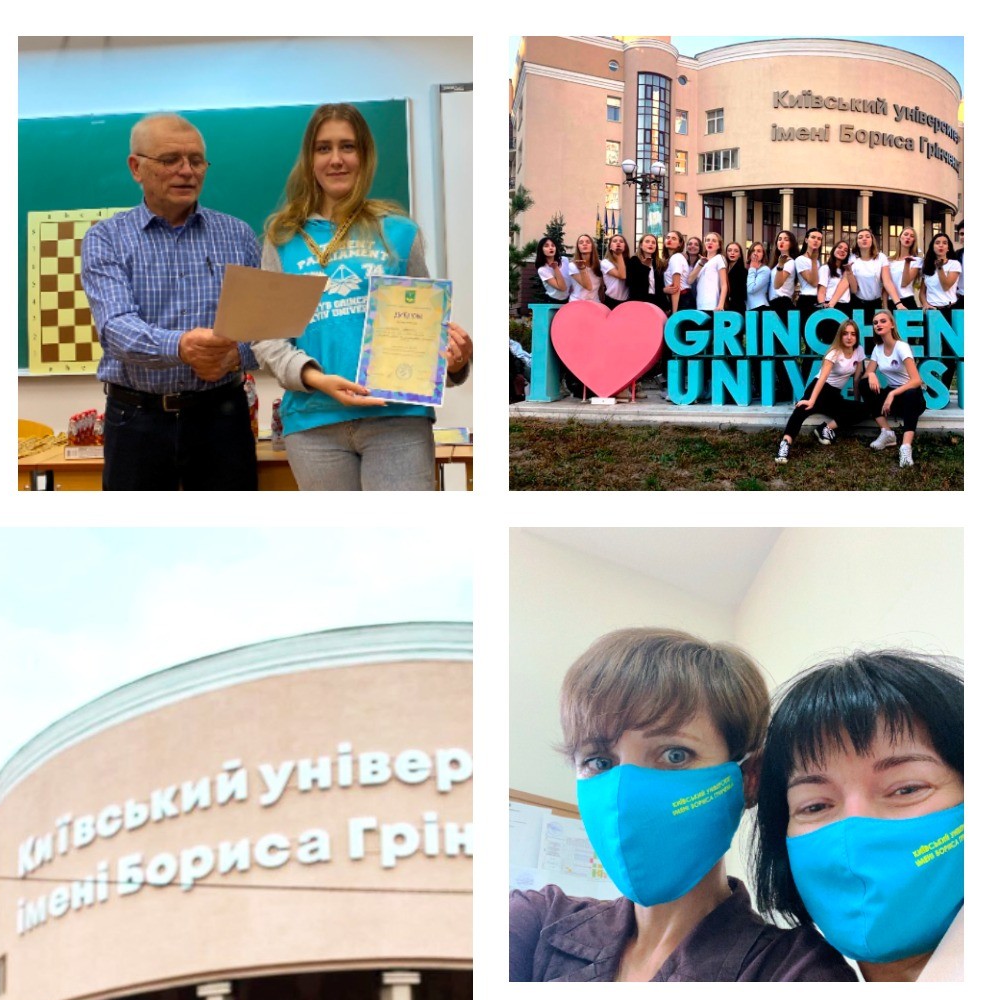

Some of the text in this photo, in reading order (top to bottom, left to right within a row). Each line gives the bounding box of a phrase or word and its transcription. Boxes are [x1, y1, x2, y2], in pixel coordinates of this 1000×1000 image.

[773, 90, 888, 115] Київський
[771, 123, 830, 142] імені
[839, 124, 914, 150] Бориса
[16, 742, 473, 878] Київський універ
[15, 862, 109, 935] імені
[117, 827, 331, 895] Бориса
